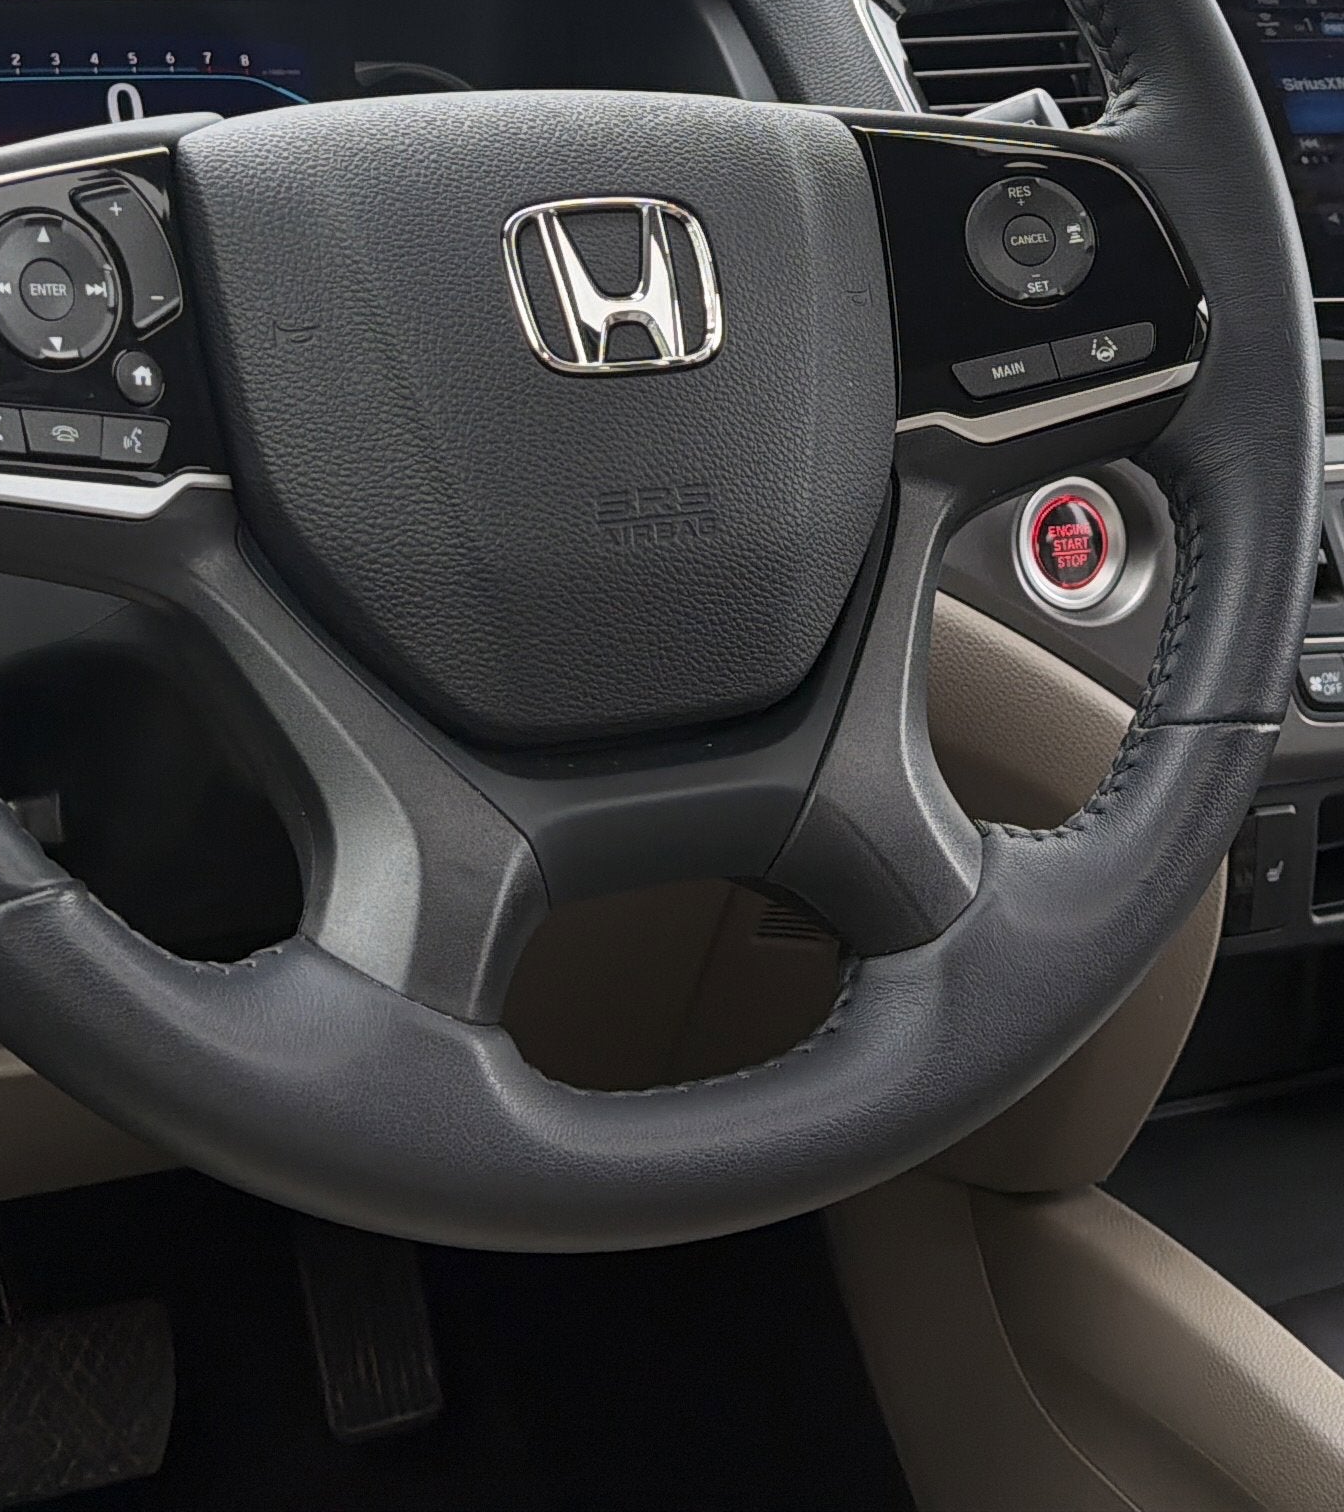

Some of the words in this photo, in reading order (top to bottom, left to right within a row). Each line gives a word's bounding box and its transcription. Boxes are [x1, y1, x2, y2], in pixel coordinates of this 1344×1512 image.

[10, 52, 22, 67] 2
[49, 52, 61, 67] 3
[88, 52, 100, 66] 4
[127, 51, 138, 65] 5
[165, 51, 176, 65] 6
[202, 51, 213, 65] 7
[239, 53, 250, 68] 8
[1008, 186, 1032, 199] RES
[1010, 233, 1050, 247] CANCEL
[29, 282, 67, 297] ENTER
[1027, 280, 1050, 294] SET
[992, 361, 1026, 380] MAIN
[1048, 523, 1092, 539] ENGINE
[1053, 537, 1090, 552] START
[1057, 553, 1088, 569] STOP
[1324, 680, 1344, 696] OFF
